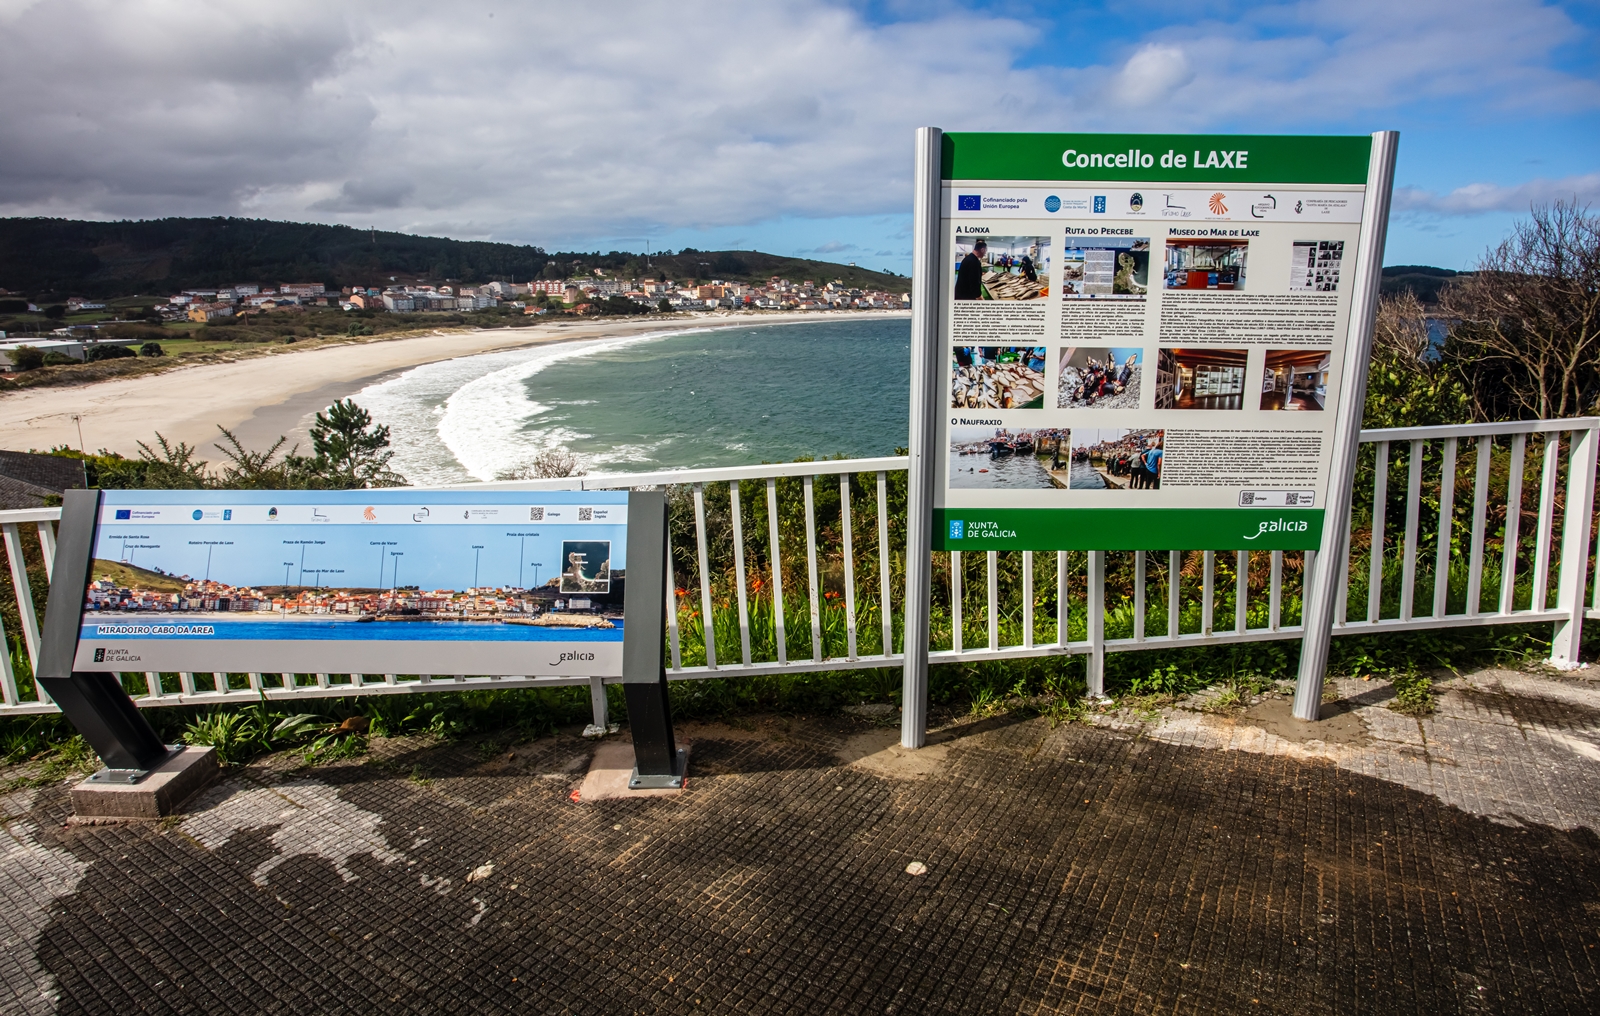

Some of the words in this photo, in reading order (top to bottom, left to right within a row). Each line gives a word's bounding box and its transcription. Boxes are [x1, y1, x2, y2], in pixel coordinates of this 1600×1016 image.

[1061, 149, 1154, 168] Concello
[1160, 149, 1187, 168] de
[1193, 150, 1248, 169] LAXE
[1169, 228, 1196, 236] MUSEO
[1241, 229, 1260, 237] LAXE
[951, 418, 958, 426] O
[1243, 517, 1308, 539] galicia
[98, 626, 150, 634] MIRADOIRO
[152, 626, 175, 634] CABO
[177, 626, 191, 634] DA
[191, 626, 214, 634] AREA
[549, 650, 595, 666] galicia
